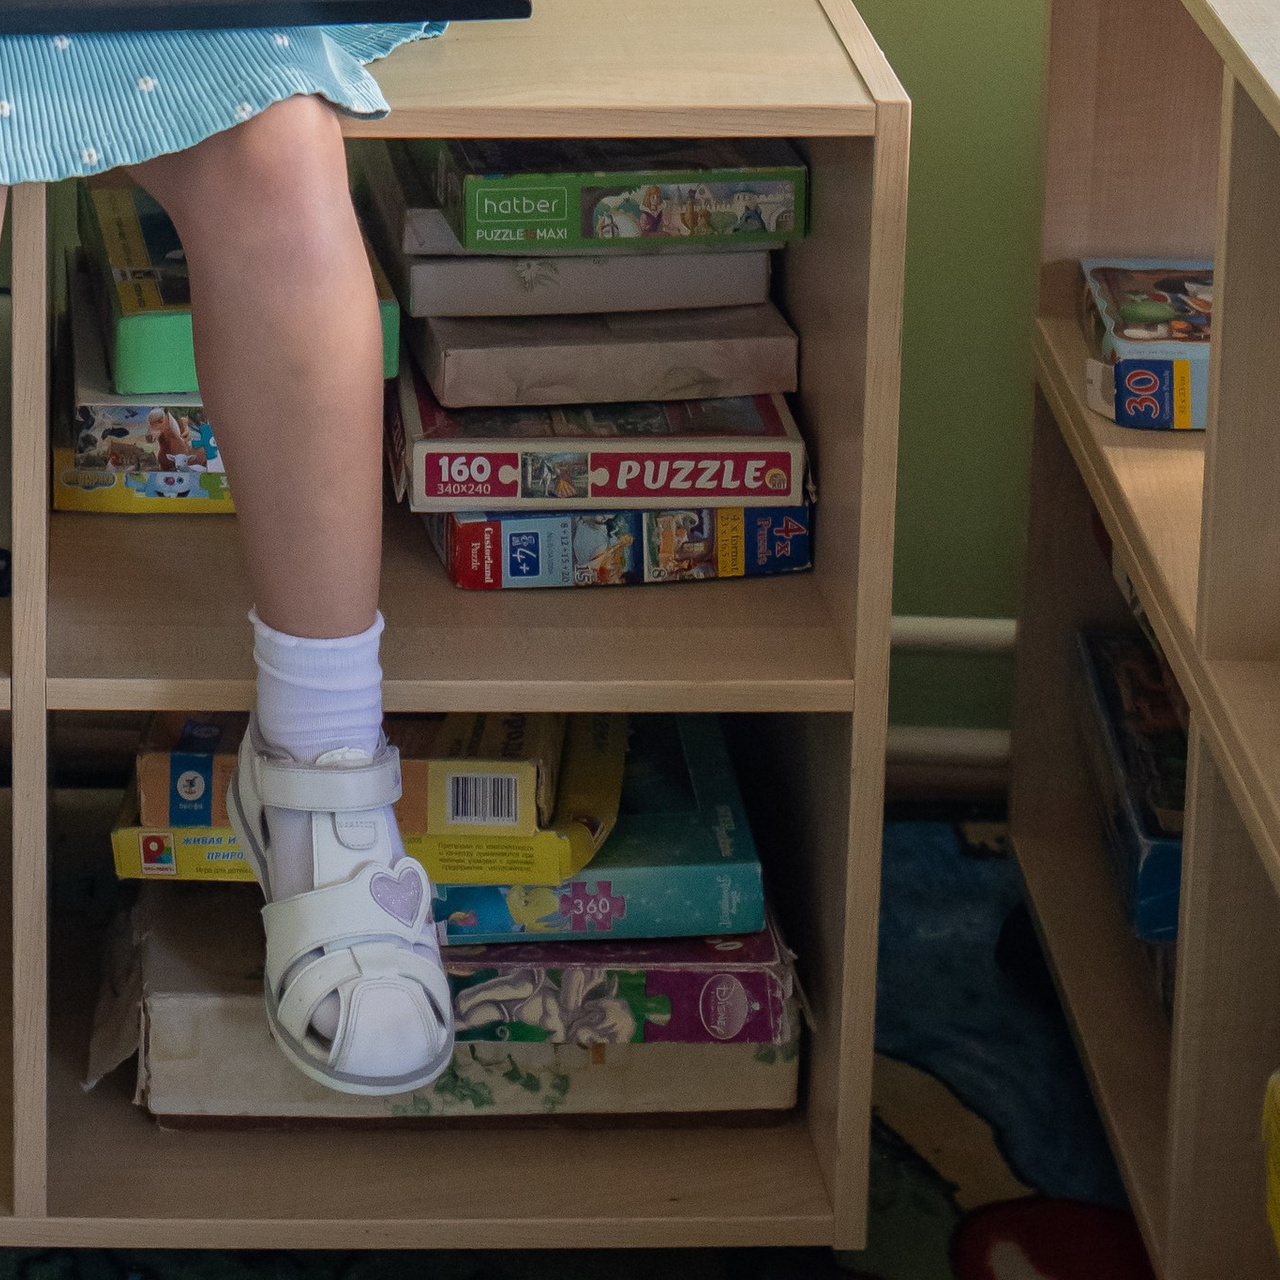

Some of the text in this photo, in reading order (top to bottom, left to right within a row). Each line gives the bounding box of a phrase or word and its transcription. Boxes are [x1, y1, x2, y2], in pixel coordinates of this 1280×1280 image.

[485, 197, 558, 214] hatber
[476, 228, 567, 240] PUZZLE MAXI
[1125, 369, 1160, 419] 30
[439, 456, 491, 483] 160
[617, 459, 766, 490] PUZZLE
[731, 535, 741, 572] format
[757, 517, 772, 566] Puzzle
[470, 542, 480, 570] Puzzle
[483, 527, 494, 584] Castorland
[182, 836, 223, 846] ЖИВАЯ
[207, 851, 246, 861] ПРИРО
[573, 898, 610, 915] 360
